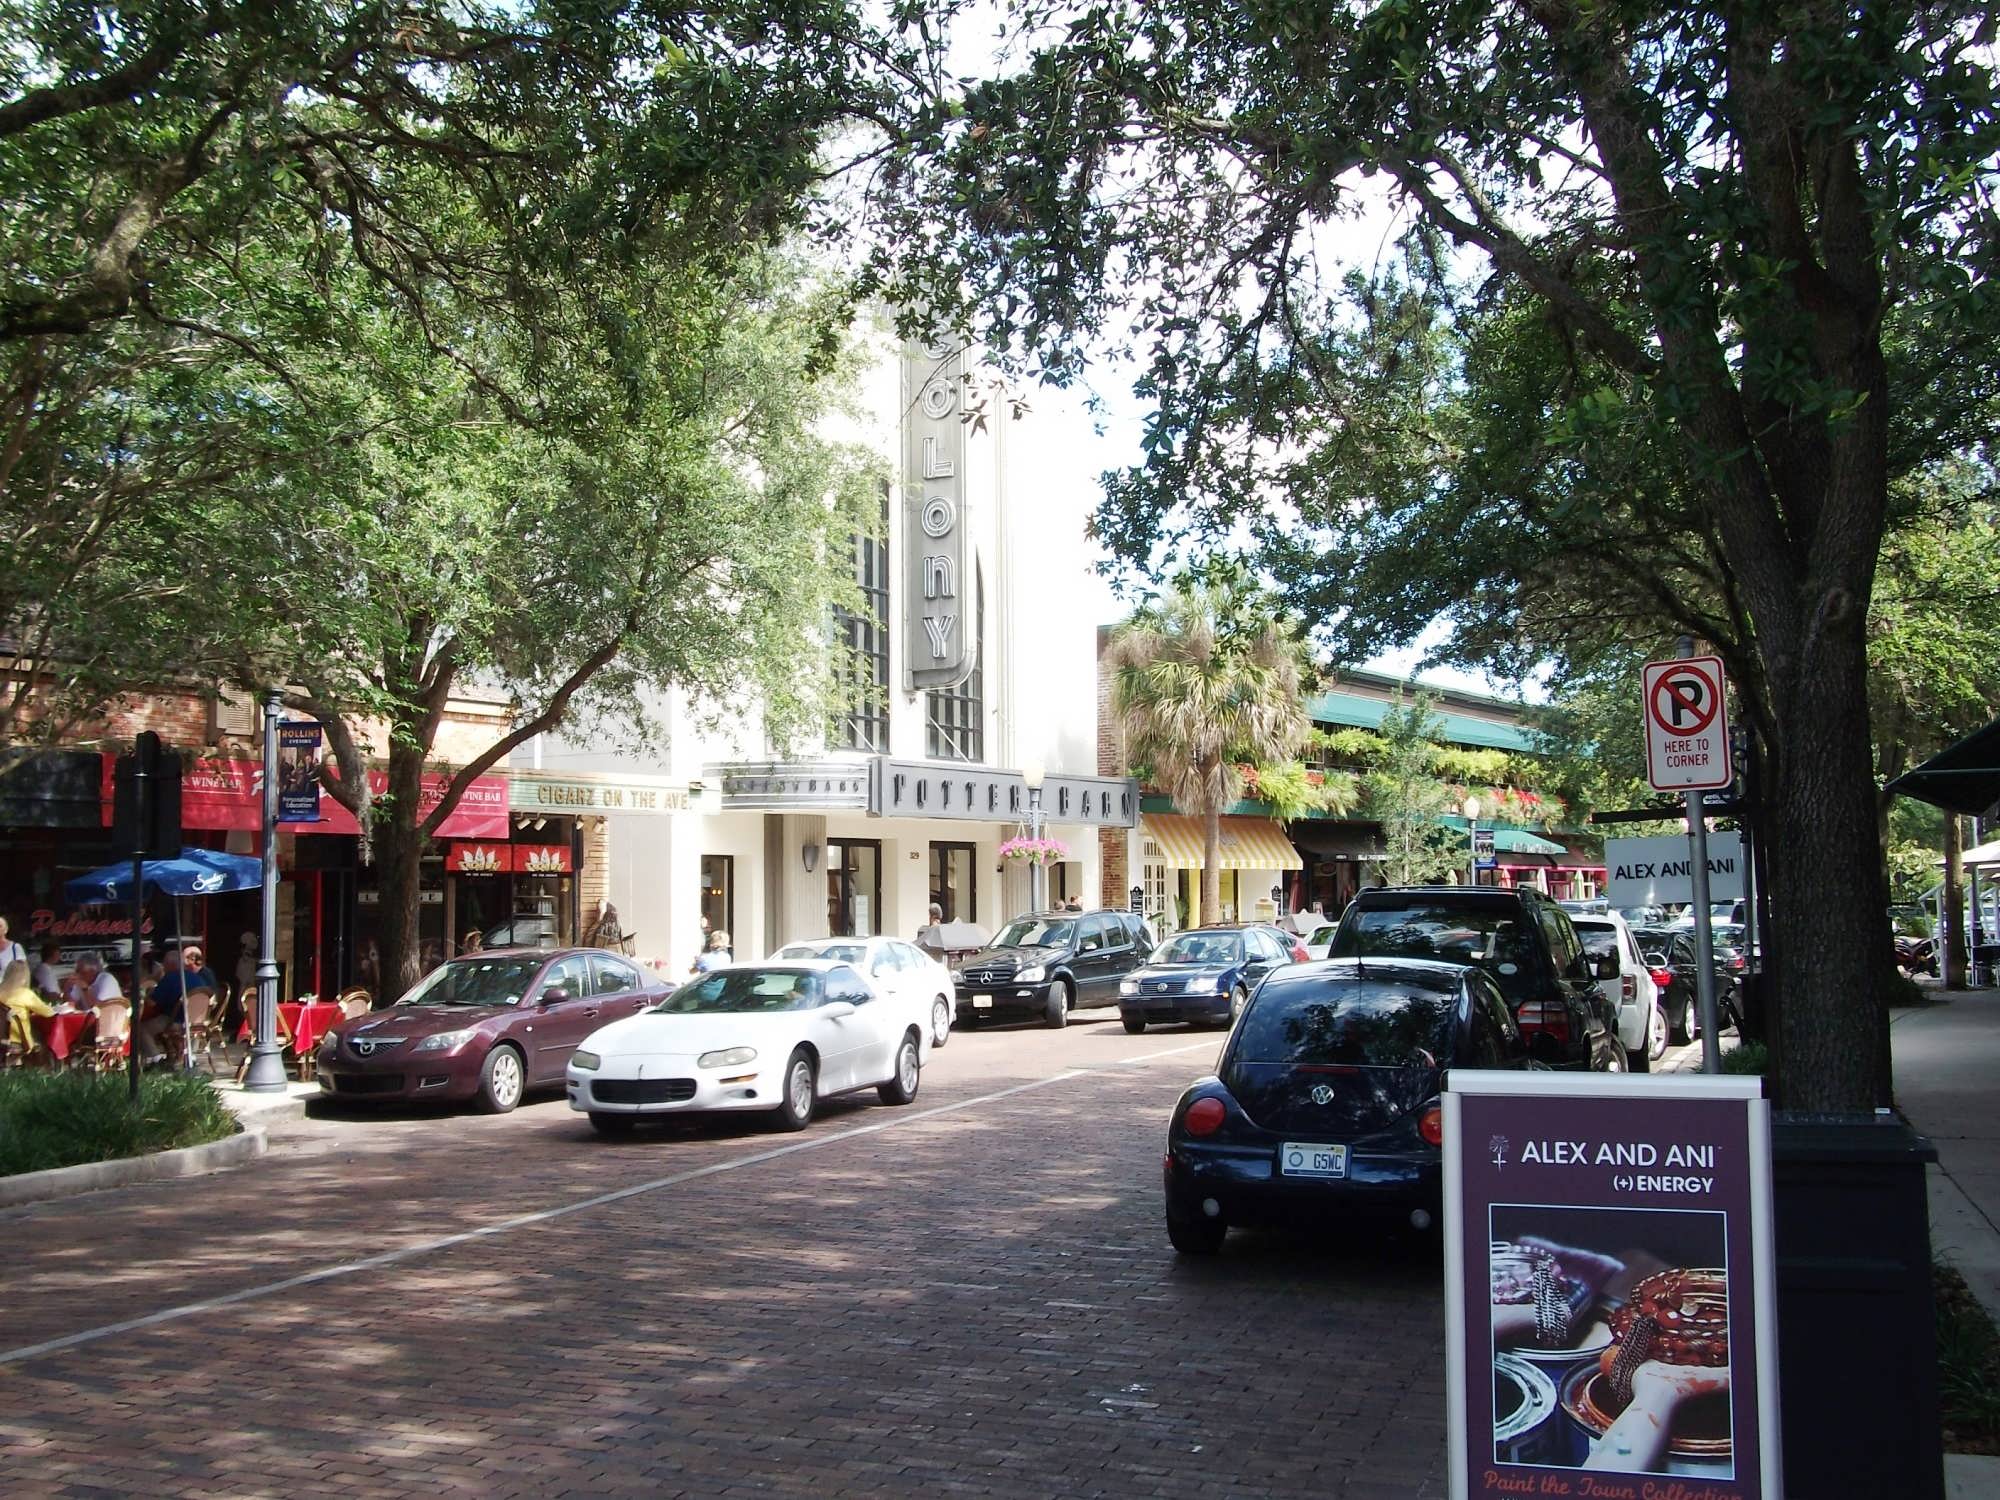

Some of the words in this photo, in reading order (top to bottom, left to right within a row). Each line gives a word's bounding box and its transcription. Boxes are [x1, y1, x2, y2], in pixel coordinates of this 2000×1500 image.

[281, 729, 320, 738] ROLLINS
[1664, 739, 1691, 753] HERE
[1696, 738, 1709, 751] TO
[1666, 753, 1709, 768] CORNER
[484, 792, 501, 802] BAR
[537, 783, 596, 805] CIGARZ
[603, 788, 623, 807] ON
[631, 790, 656, 808] THE
[893, 773, 1041, 813] POTTER
[1058, 786, 1132, 819] BARN
[1615, 863, 1655, 880] ALEX
[1705, 858, 1735, 875] ANI
[1521, 1141, 1588, 1165] ALEX
[1595, 1143, 1657, 1166] AND
[1664, 1144, 1714, 1168] ANI
[1637, 1175, 1714, 1193] ENERGY
[1483, 1470, 1537, 1493] Paint
[1540, 1473, 1571, 1496] the
[1579, 1476, 1636, 1500] Town
